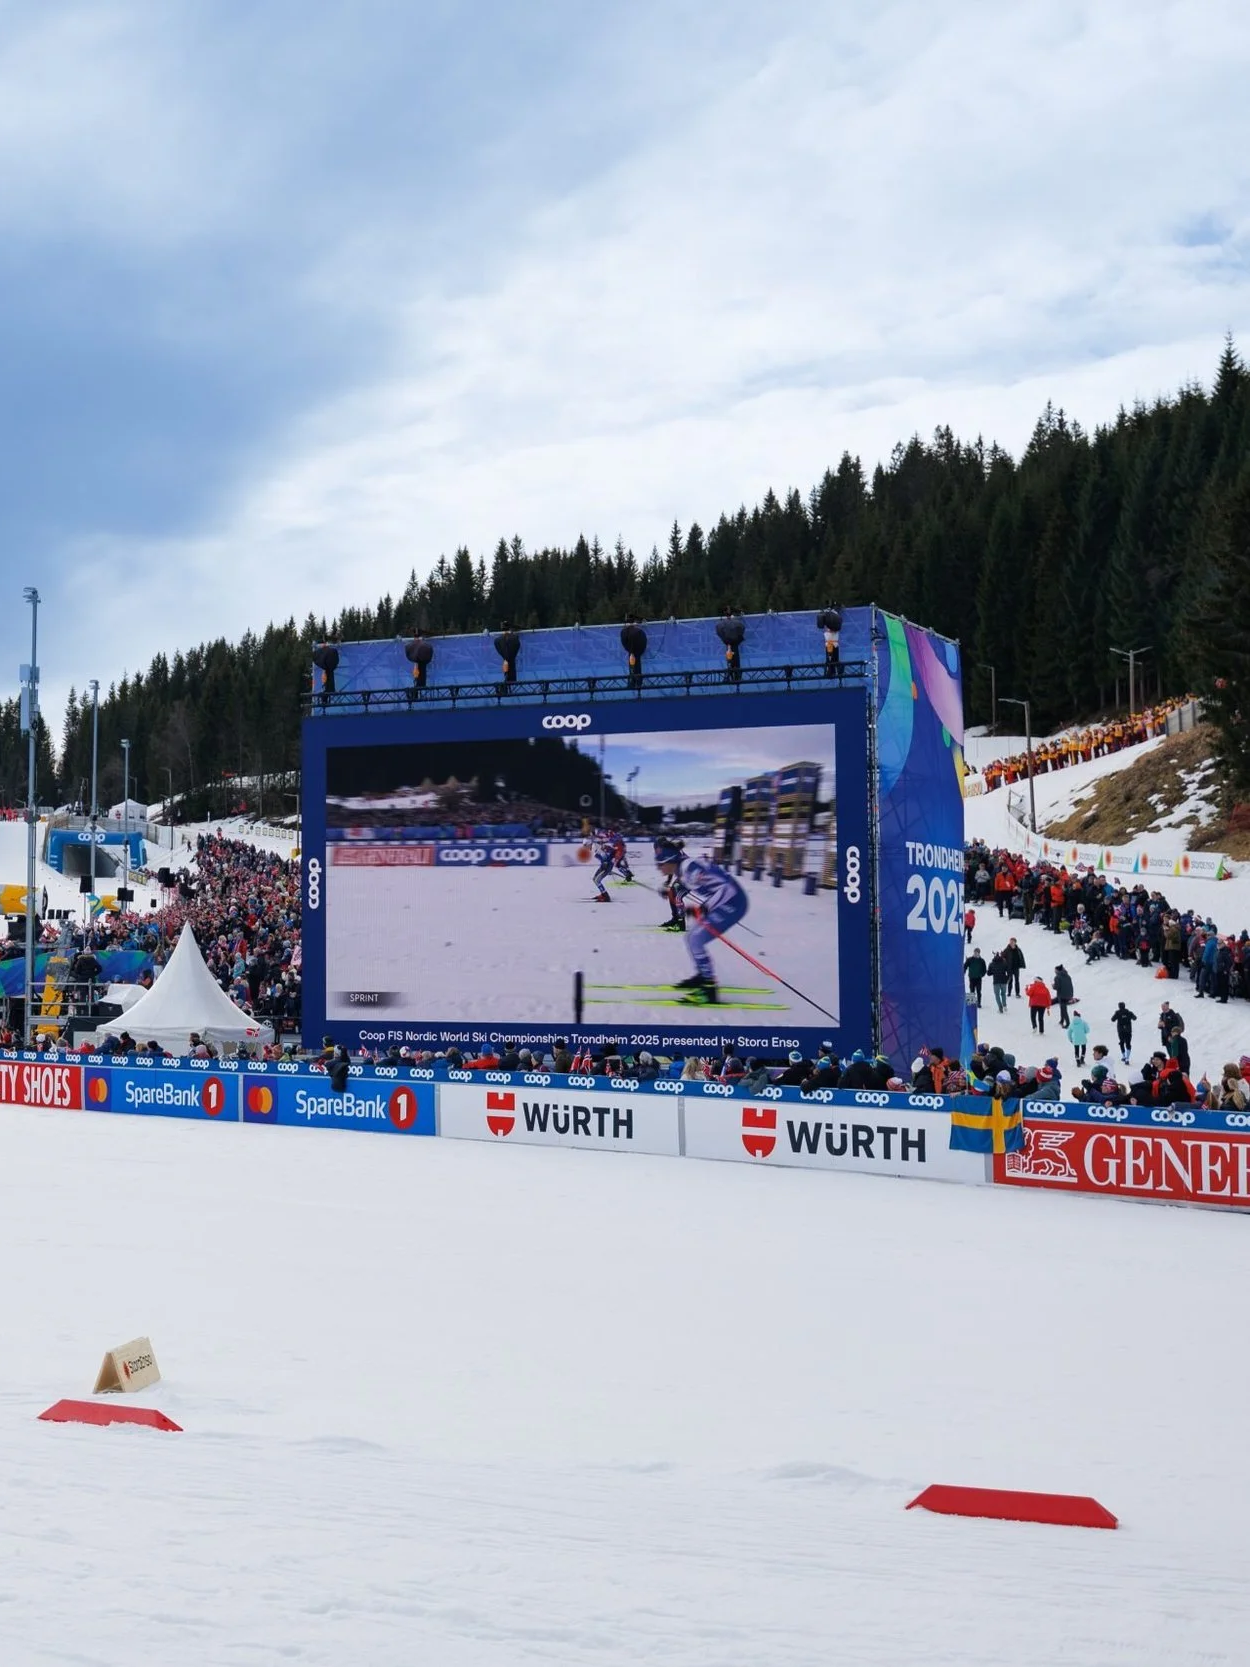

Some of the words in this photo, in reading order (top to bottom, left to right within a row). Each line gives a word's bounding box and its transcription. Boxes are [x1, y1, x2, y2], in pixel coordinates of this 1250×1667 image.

[542, 714, 591, 730] coop
[439, 849, 486, 864] coop
[491, 848, 540, 864] coop
[308, 858, 322, 909] coop
[844, 846, 861, 903] coop
[349, 993, 379, 1002] SPRINT
[359, 1030, 385, 1041] Coop
[387, 1030, 403, 1041] FIS
[405, 1031, 438, 1042] Nordic
[440, 1032, 469, 1042] World
[472, 1032, 488, 1042] Ski
[571, 1033, 628, 1045] Trondheim
[631, 1034, 660, 1046] 2025
[662, 1035, 718, 1048] presented
[737, 1036, 769, 1047] Stora
[771, 1037, 800, 1048] Enso
[23, 1065, 71, 1107] SHOES
[24, 1051, 37, 1061] coop
[44, 1052, 59, 1063] coop
[65, 1054, 81, 1064] coop
[88, 1054, 103, 1064] coop
[111, 1056, 128, 1066] coop
[136, 1057, 153, 1067] coop
[162, 1058, 181, 1068] coop
[190, 1059, 209, 1070] coop
[219, 1060, 238, 1071] coop
[247, 1061, 267, 1072] coop
[277, 1063, 298, 1074] coop
[375, 1067, 398, 1078] coop
[410, 1068, 434, 1080] coop
[449, 1070, 472, 1082] coop
[485, 1072, 511, 1084] coop
[524, 1073, 551, 1086] coop
[568, 1076, 595, 1089] coop
[610, 1078, 639, 1091] coop
[654, 1080, 684, 1094] coop
[703, 1083, 734, 1097] coop
[855, 1091, 889, 1106] coop
[908, 1095, 944, 1110] coop
[125, 1081, 200, 1108] SpareBank
[208, 1083, 217, 1109] 1
[295, 1090, 386, 1120] SpareBank
[397, 1093, 407, 1121] 1
[523, 1102, 633, 1139] WÜRTH
[1026, 1101, 1066, 1117] coop
[1087, 1105, 1128, 1122] coop
[1151, 1109, 1195, 1126] coop
[1225, 1114, 1250, 1127] co
[786, 1120, 926, 1162] WÜRTH
